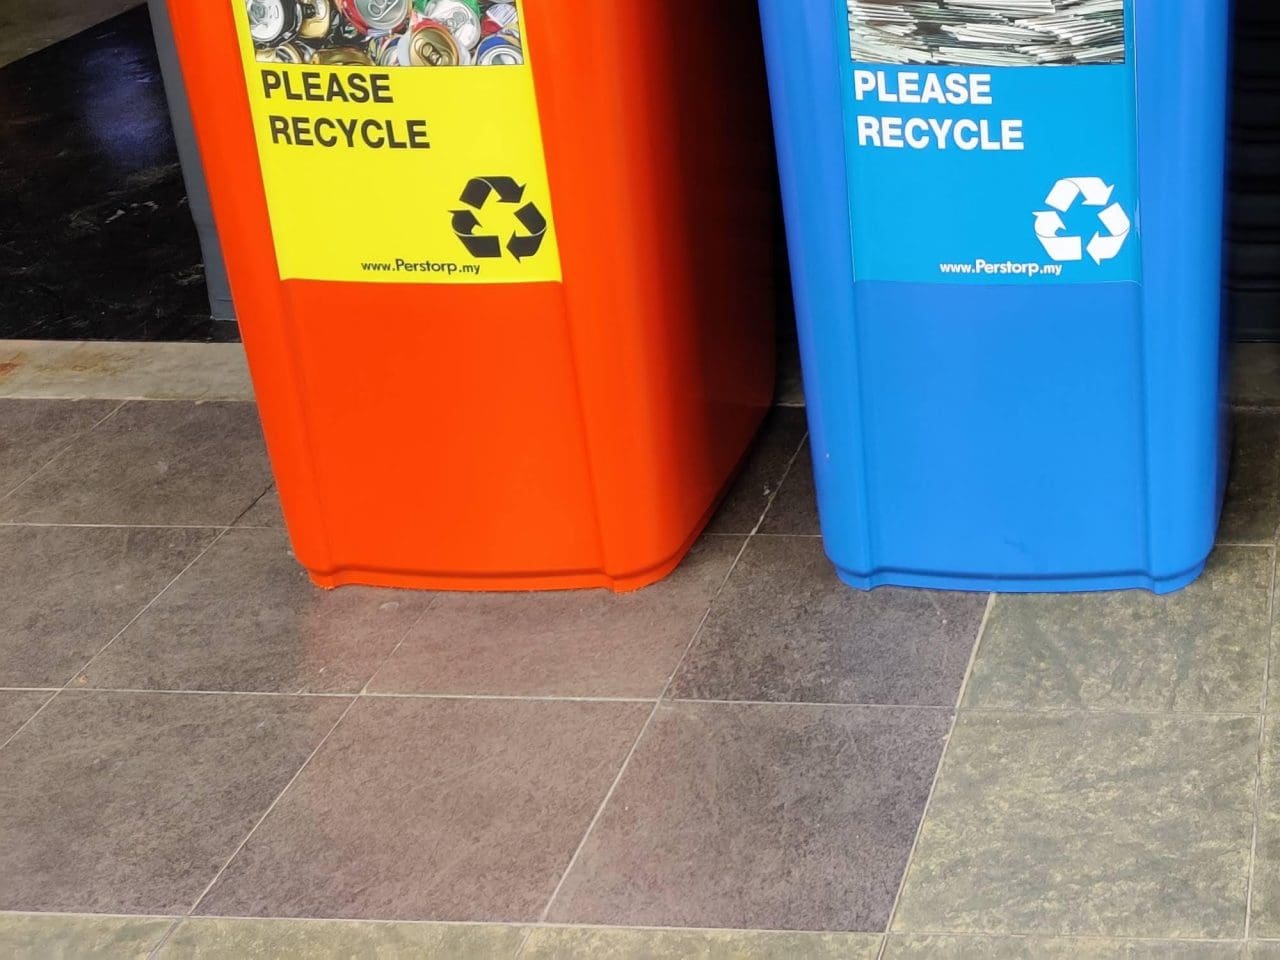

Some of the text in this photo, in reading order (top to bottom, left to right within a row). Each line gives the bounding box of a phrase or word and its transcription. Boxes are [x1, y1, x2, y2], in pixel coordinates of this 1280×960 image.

[261, 70, 394, 104] PLEASE
[853, 70, 993, 105] PLEASE
[268, 115, 430, 149] RECYCLE
[857, 115, 1024, 150] RECYCLE
[361, 258, 480, 276] www.Perstorp.my
[939, 259, 1063, 277] www.Perstorp.my
